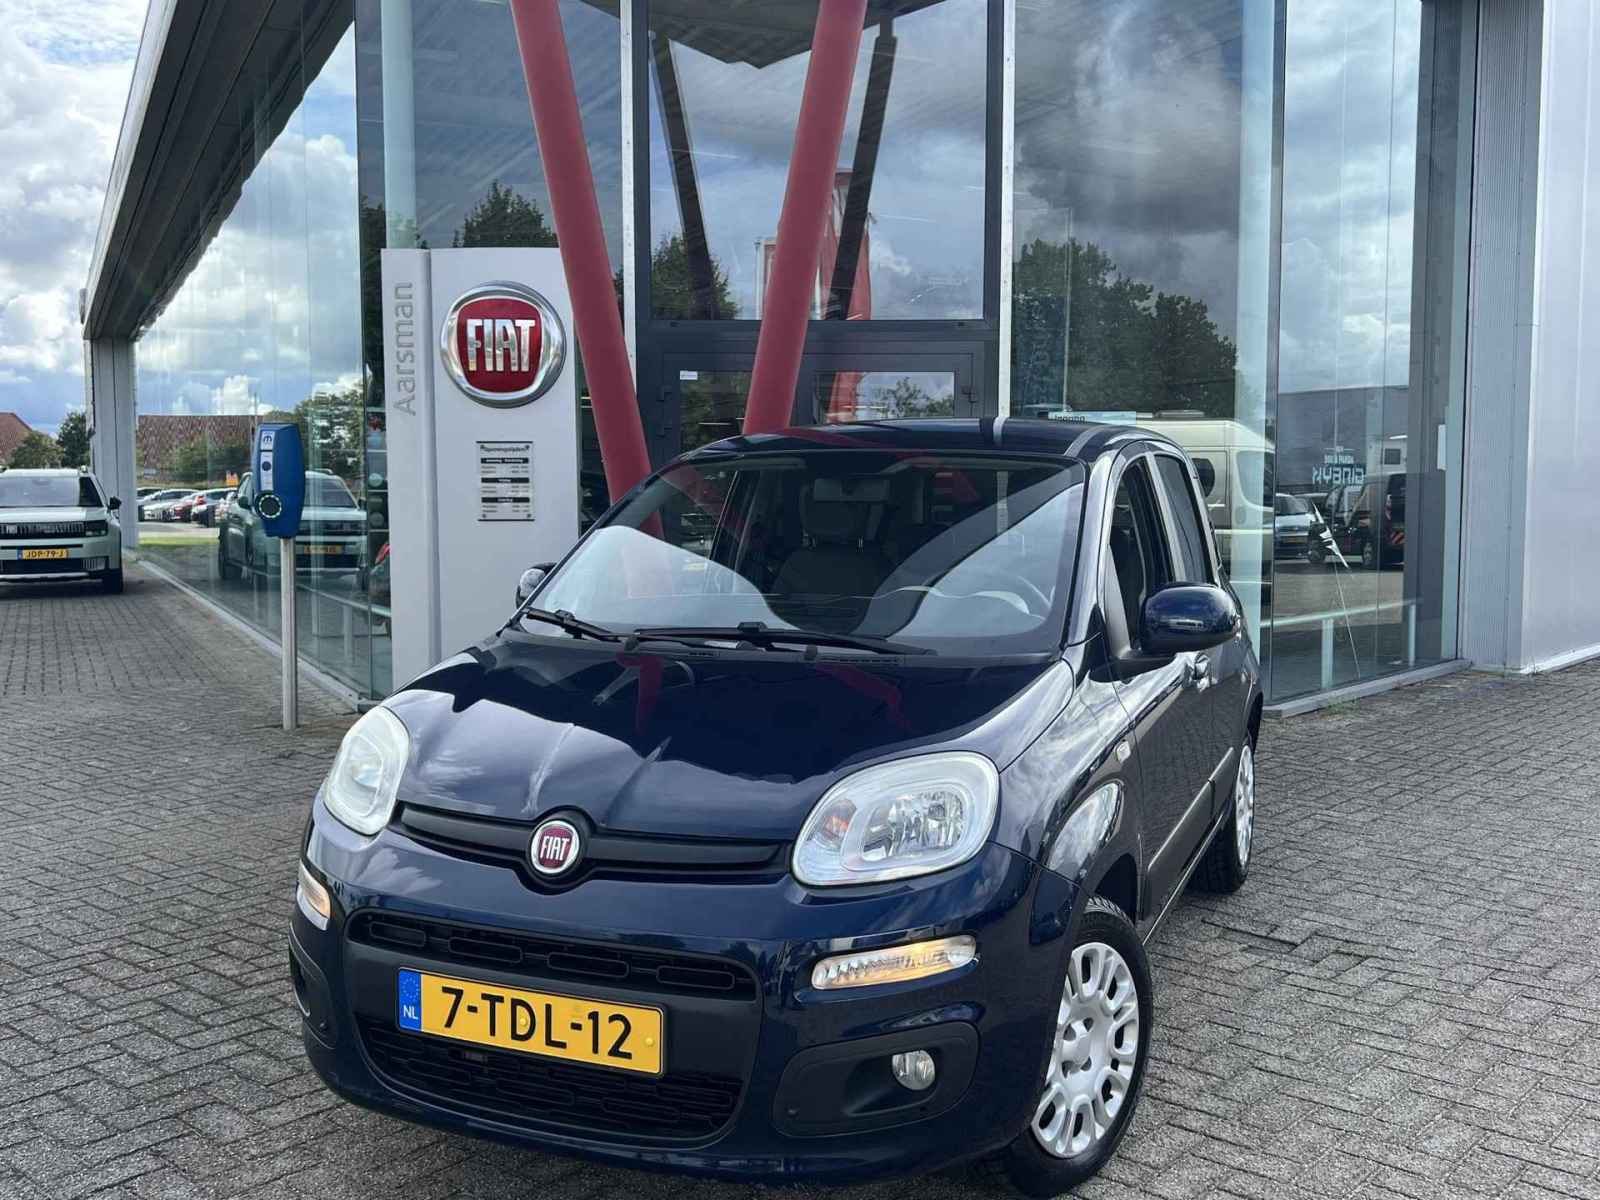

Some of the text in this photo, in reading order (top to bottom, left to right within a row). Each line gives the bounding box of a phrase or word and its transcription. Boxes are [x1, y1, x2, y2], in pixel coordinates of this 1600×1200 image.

[394, 282, 417, 417] Aarsman
[466, 318, 536, 371] FIAT
[540, 835, 570, 861] FIAT
[402, 1004, 419, 1020] NL
[441, 985, 633, 1060] 7-TDL-12
